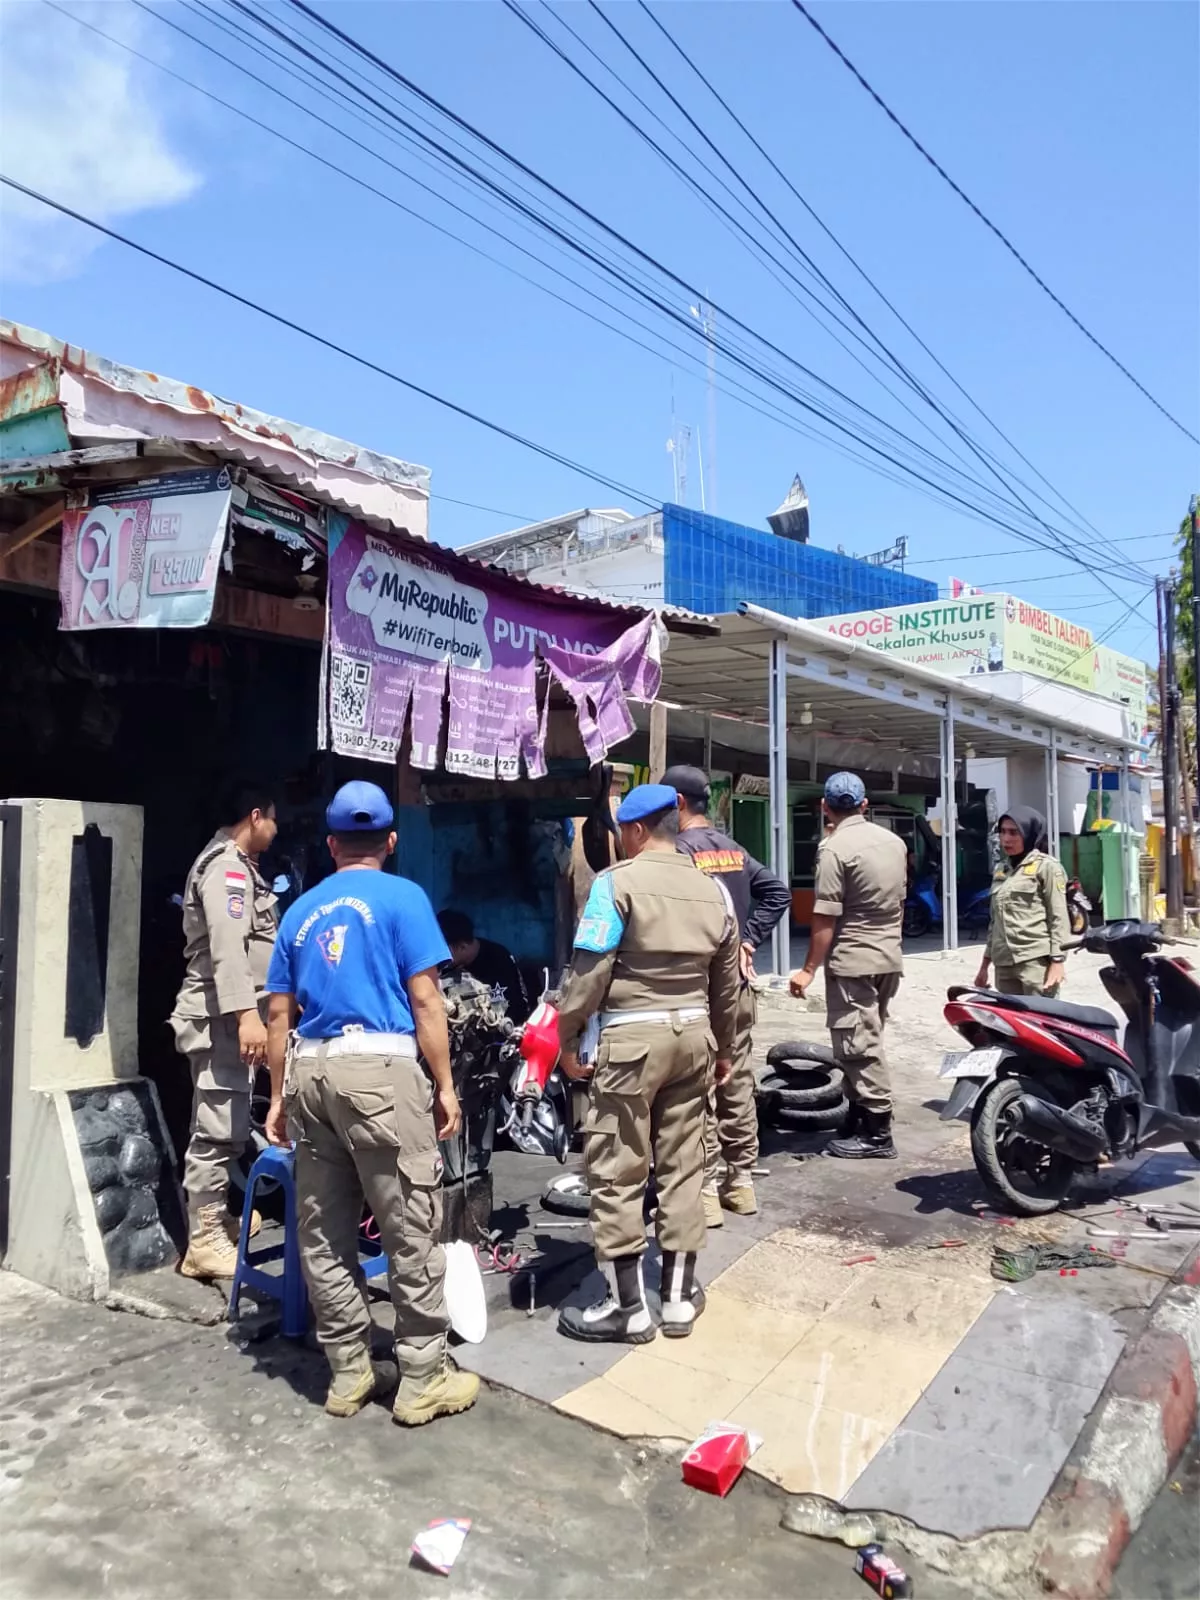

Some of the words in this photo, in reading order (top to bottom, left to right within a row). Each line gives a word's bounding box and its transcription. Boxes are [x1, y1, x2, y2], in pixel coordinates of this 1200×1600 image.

[379, 571, 478, 625] MyRepublic
[382, 618, 483, 660] #WifiTerbaik
[829, 616, 893, 638] AGOGE
[900, 602, 996, 631] INSTITUTE
[930, 629, 986, 643] Khusus
[1019, 602, 1053, 636] BIMBEL
[1054, 617, 1092, 650] TALENTA
[916, 653, 944, 664] AKMIL
